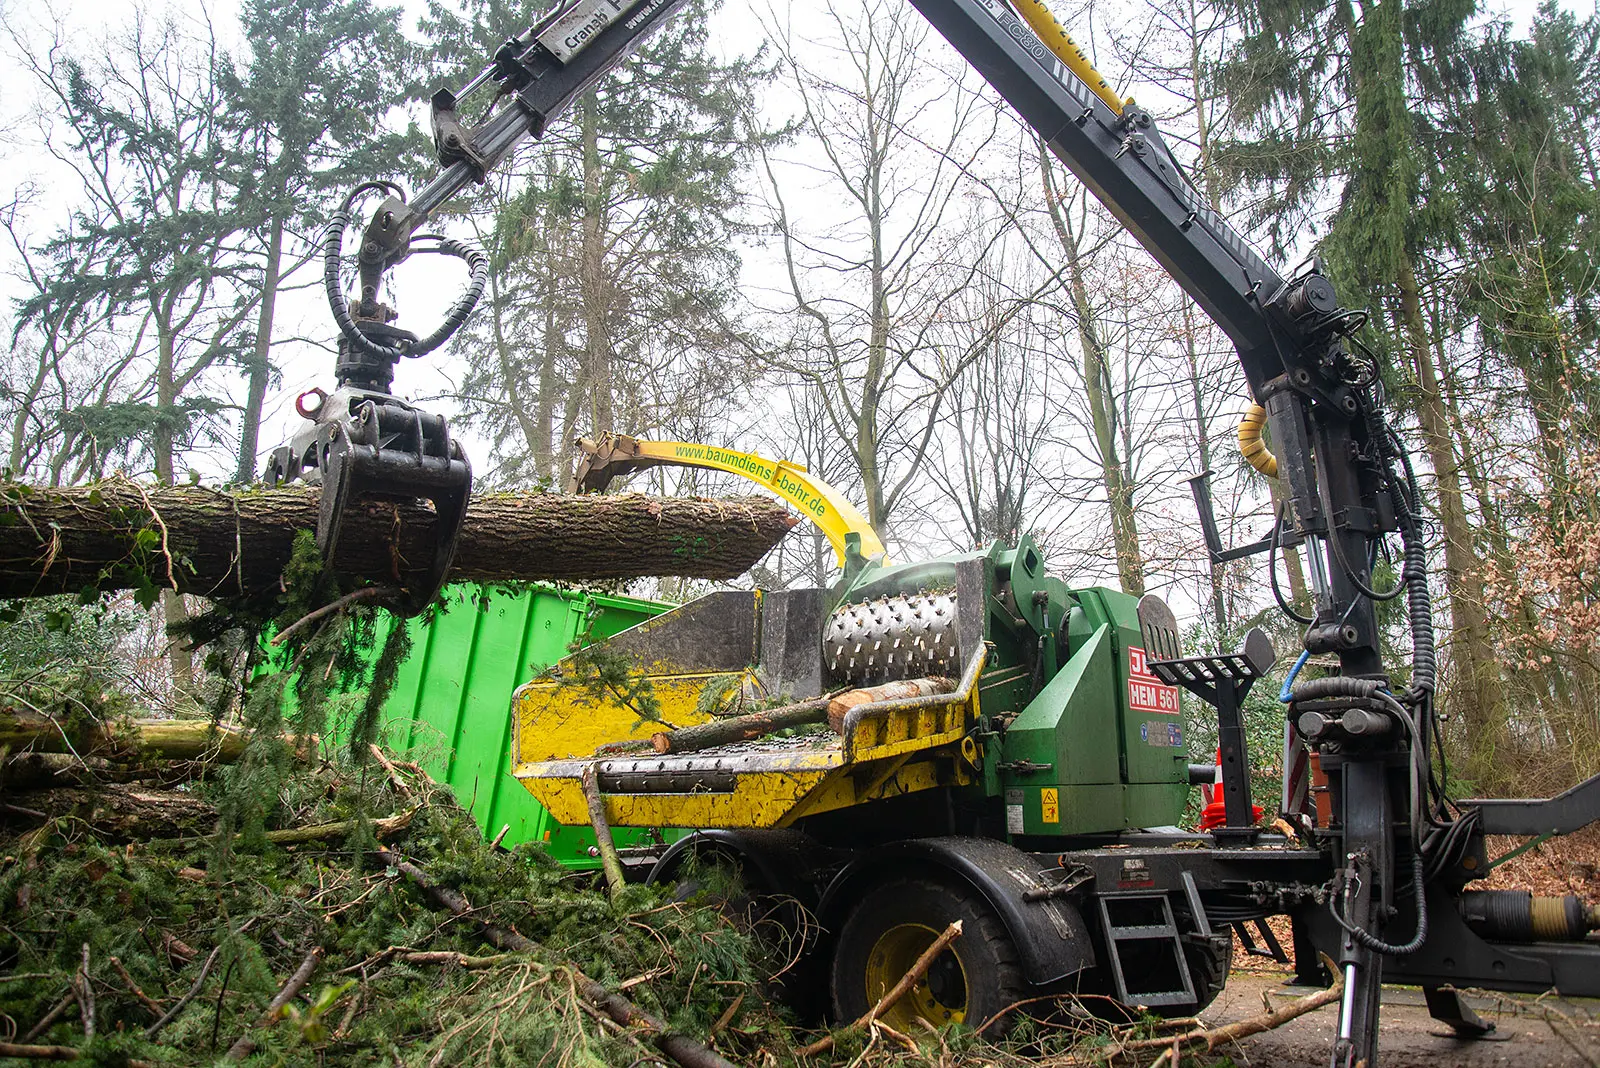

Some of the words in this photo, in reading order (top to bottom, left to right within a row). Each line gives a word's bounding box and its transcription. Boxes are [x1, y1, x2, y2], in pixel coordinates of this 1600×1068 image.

[565, 13, 609, 49] Cranab
[997, 10, 1046, 60] FC80
[1130, 684, 1157, 707] HEM
[1160, 689, 1178, 710] 561
